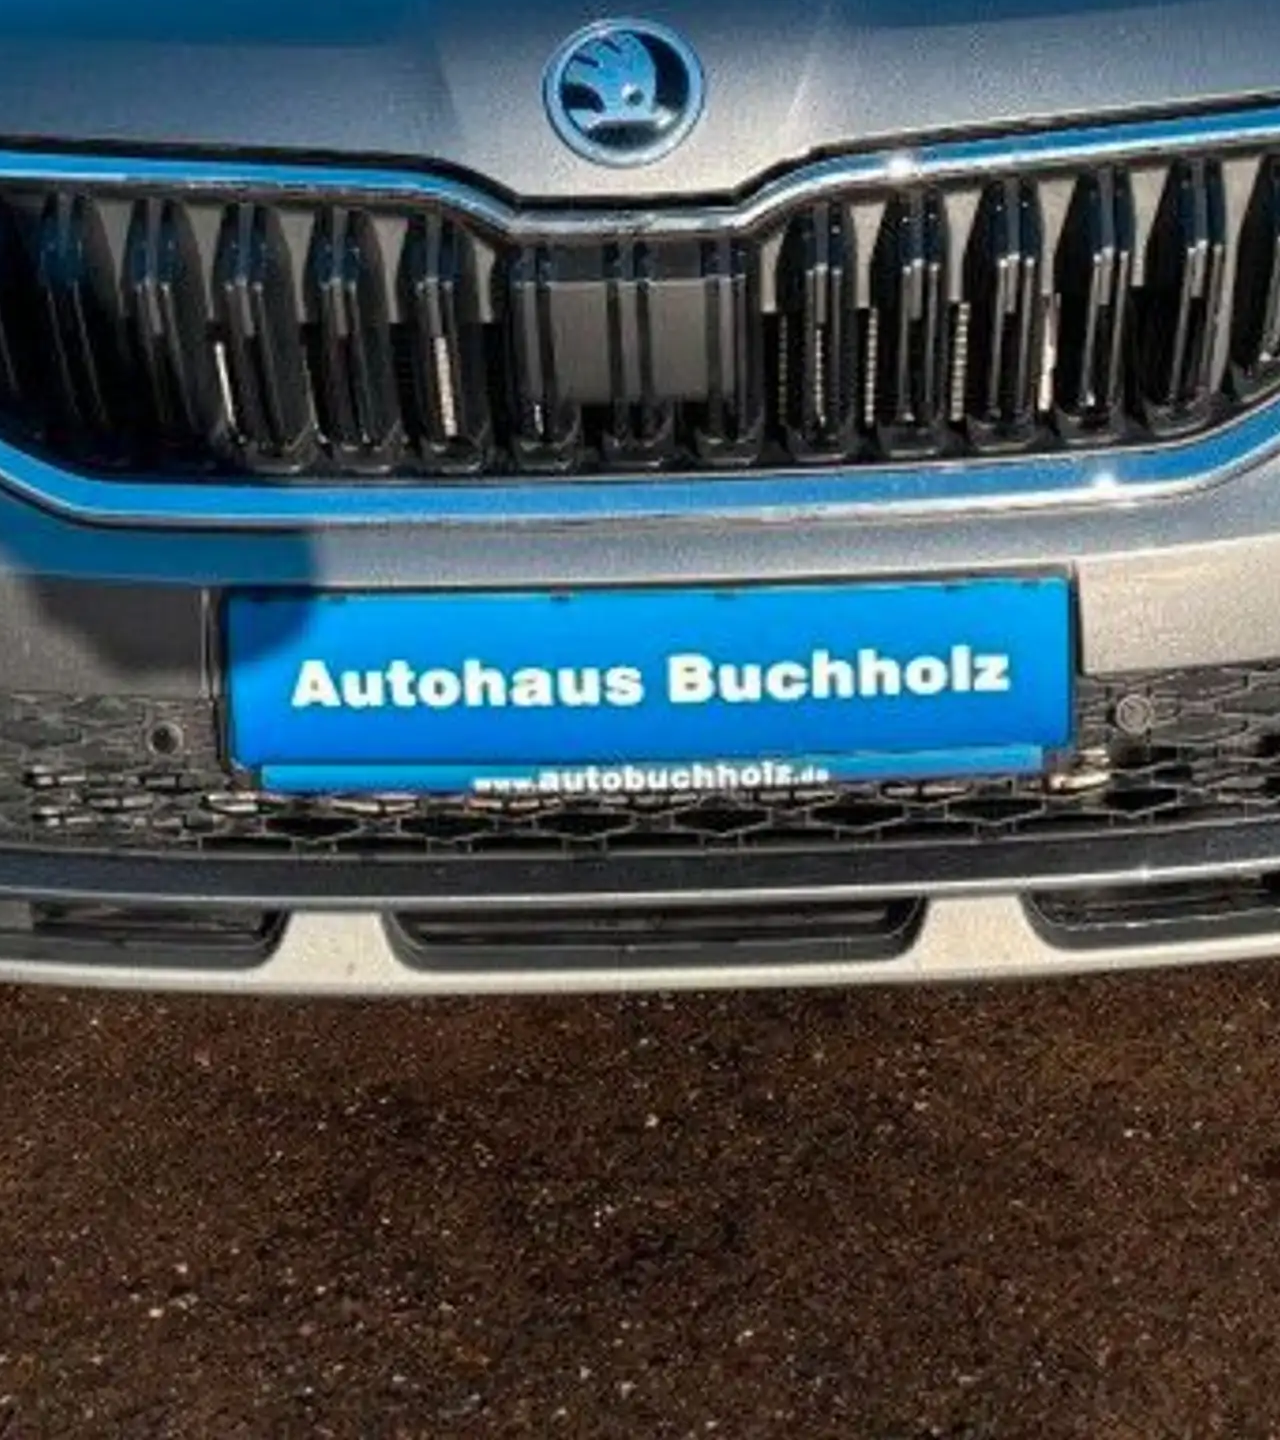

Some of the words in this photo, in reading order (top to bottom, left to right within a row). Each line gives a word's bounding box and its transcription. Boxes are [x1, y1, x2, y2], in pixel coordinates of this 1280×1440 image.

[292, 658, 644, 708] Autohaus
[666, 645, 1010, 704] Buchholz
[474, 761, 830, 793] www.autobuchholz.de
